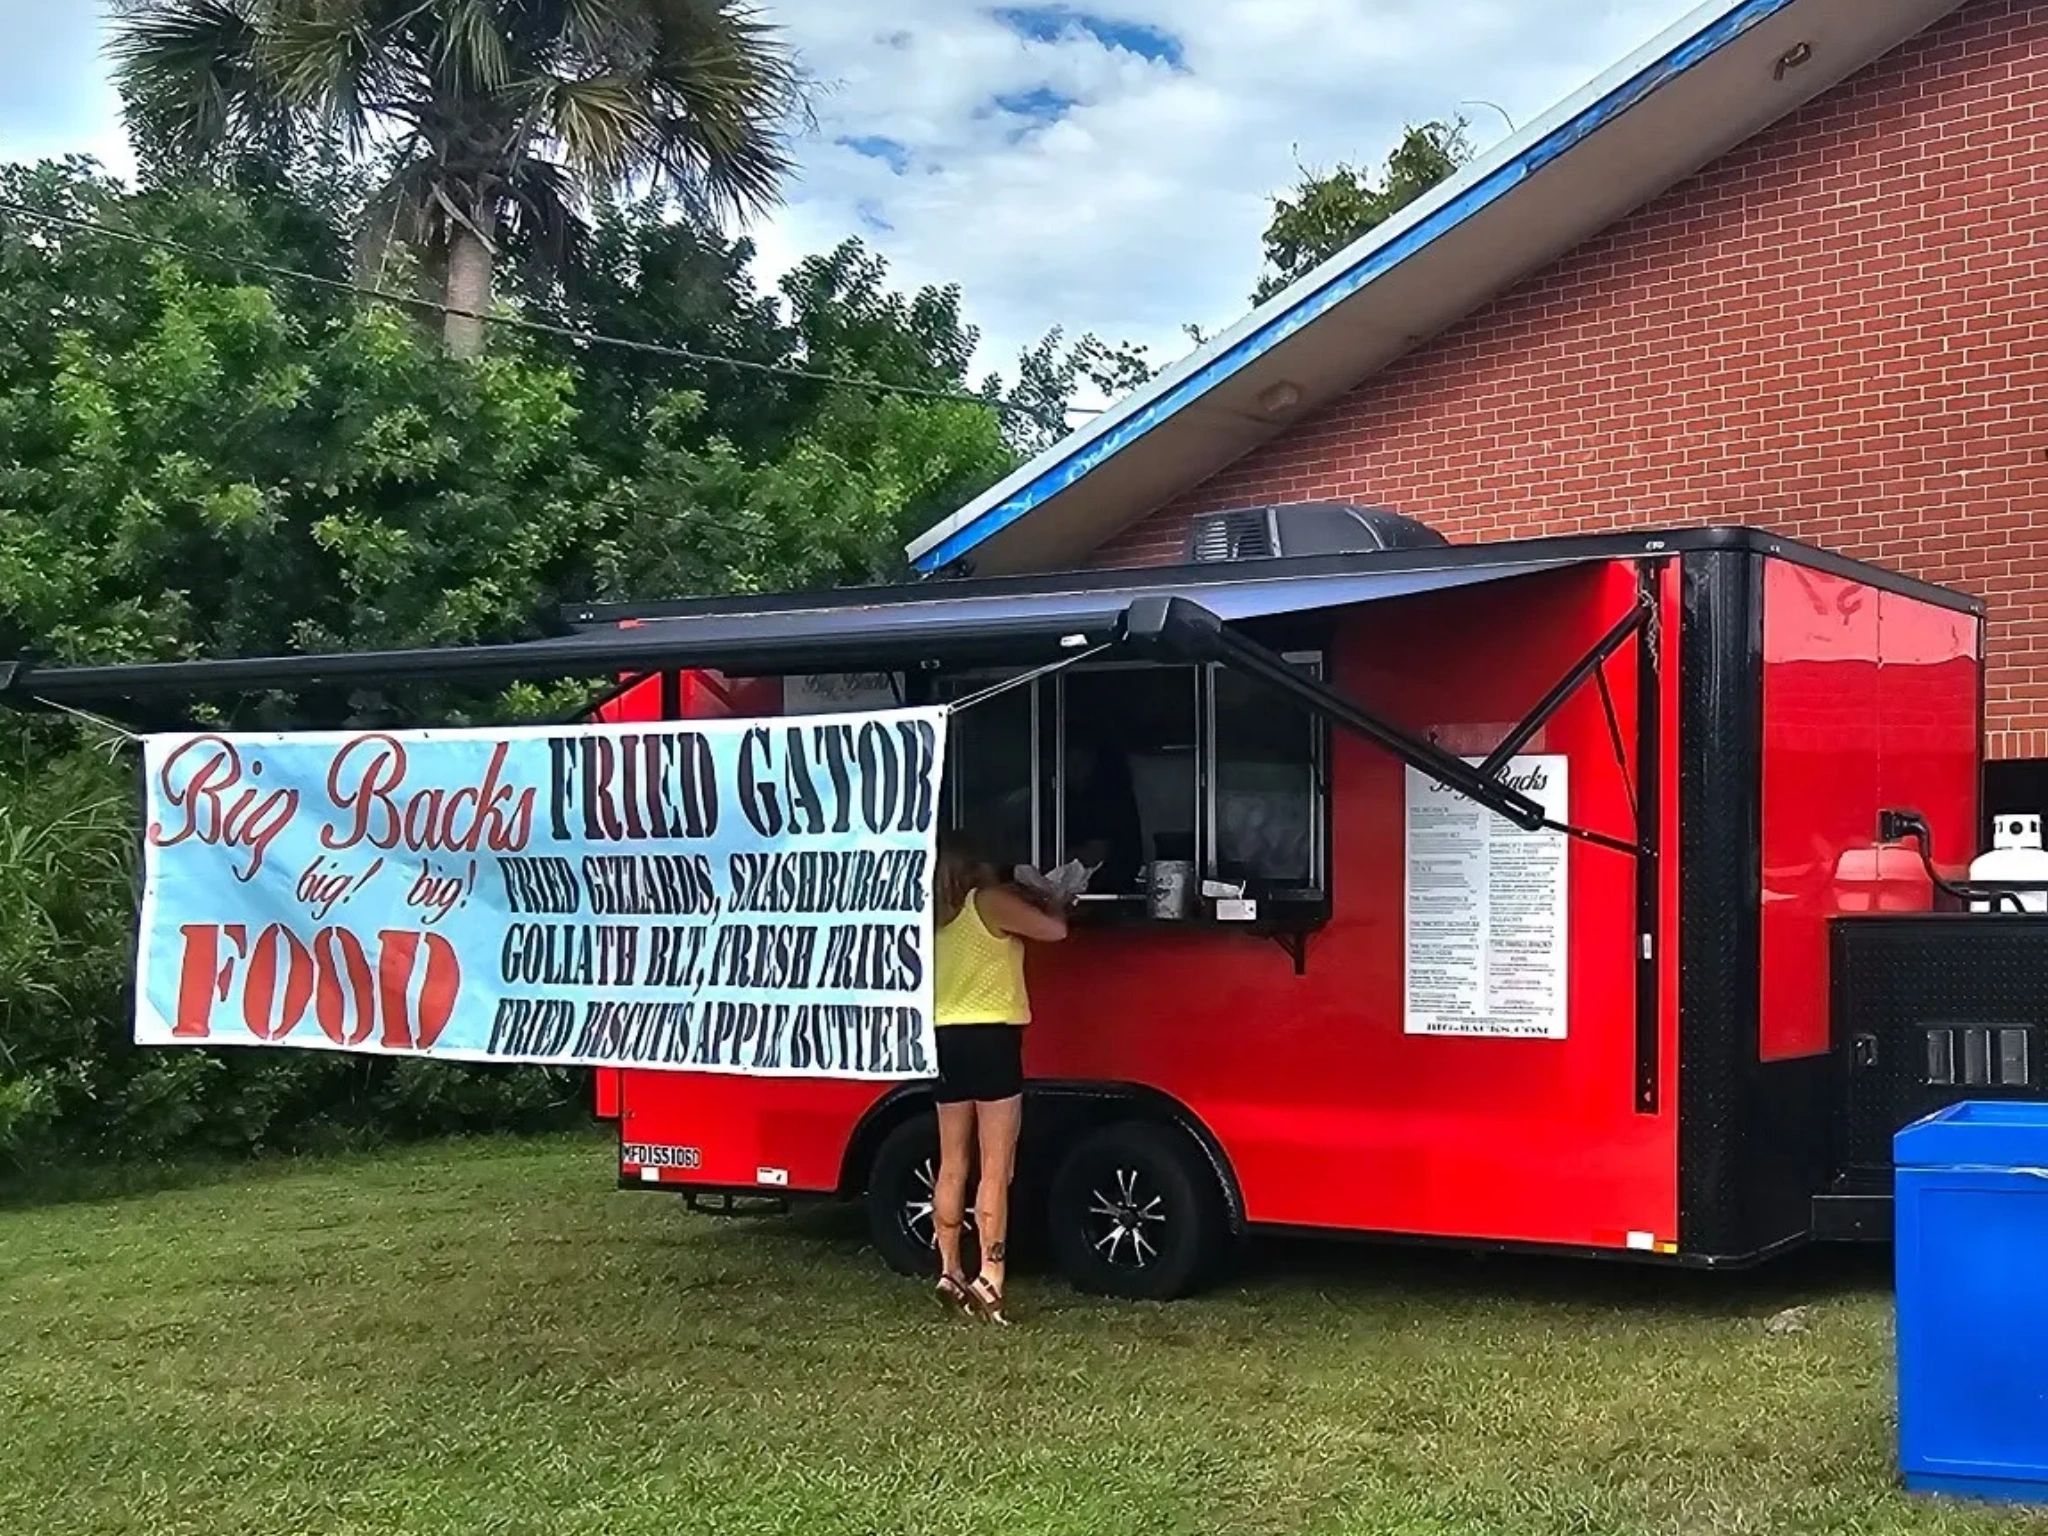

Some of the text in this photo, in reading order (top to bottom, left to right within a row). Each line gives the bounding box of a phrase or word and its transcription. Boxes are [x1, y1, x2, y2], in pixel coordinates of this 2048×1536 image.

[150, 733, 537, 882] Big Backs
[549, 720, 936, 841] FRIED GATOR
[296, 855, 476, 924] big! big!
[498, 849, 927, 924] FRIED GIZZARDS, SMASHBURGER
[172, 923, 460, 1050] FOOD
[501, 923, 923, 996] GOLIATH BLT, FRESH FRIES
[487, 998, 928, 1074] FRIED BISCUITS APPLE BUTTER
